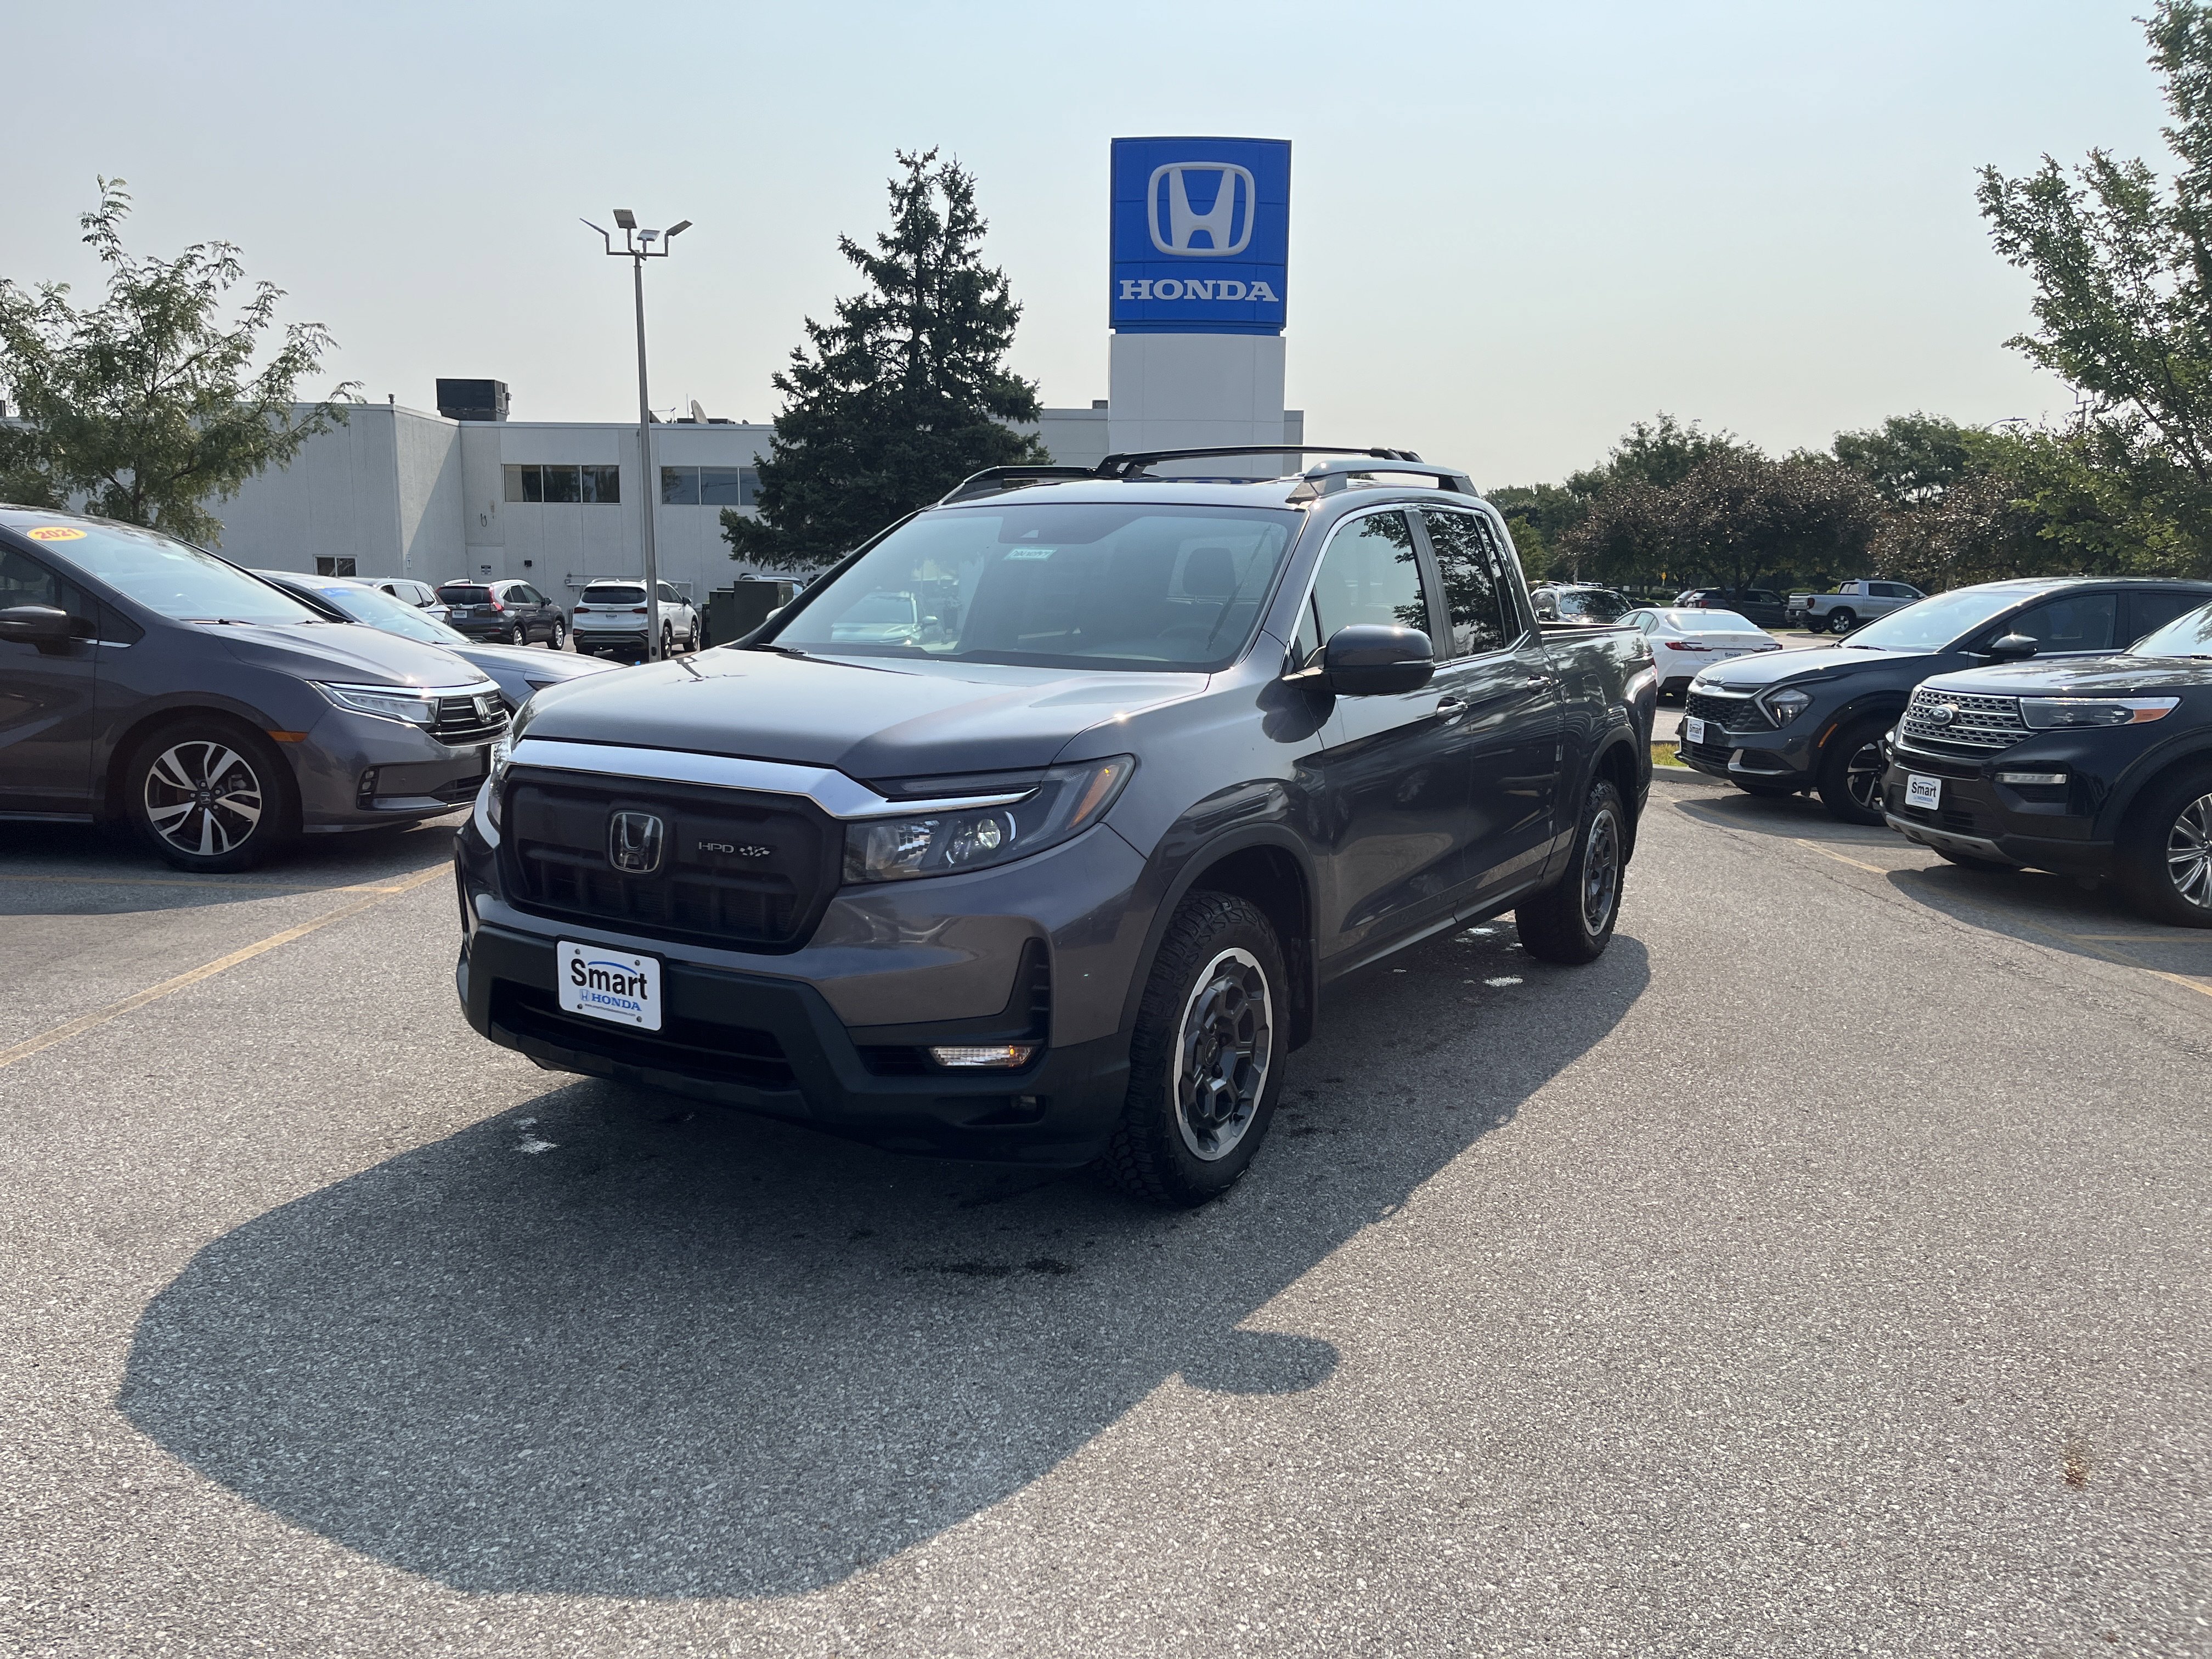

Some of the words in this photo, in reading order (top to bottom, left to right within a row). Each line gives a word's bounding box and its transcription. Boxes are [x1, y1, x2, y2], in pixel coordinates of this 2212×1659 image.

[1119, 279, 1279, 302] HONDA
[35, 528, 80, 539] 2021
[1689, 723, 1702, 735] Smart
[1911, 781, 1937, 798] Smart
[698, 842, 735, 853] HPD
[571, 958, 648, 1000] Smart
[591, 992, 642, 1012] HONDA
